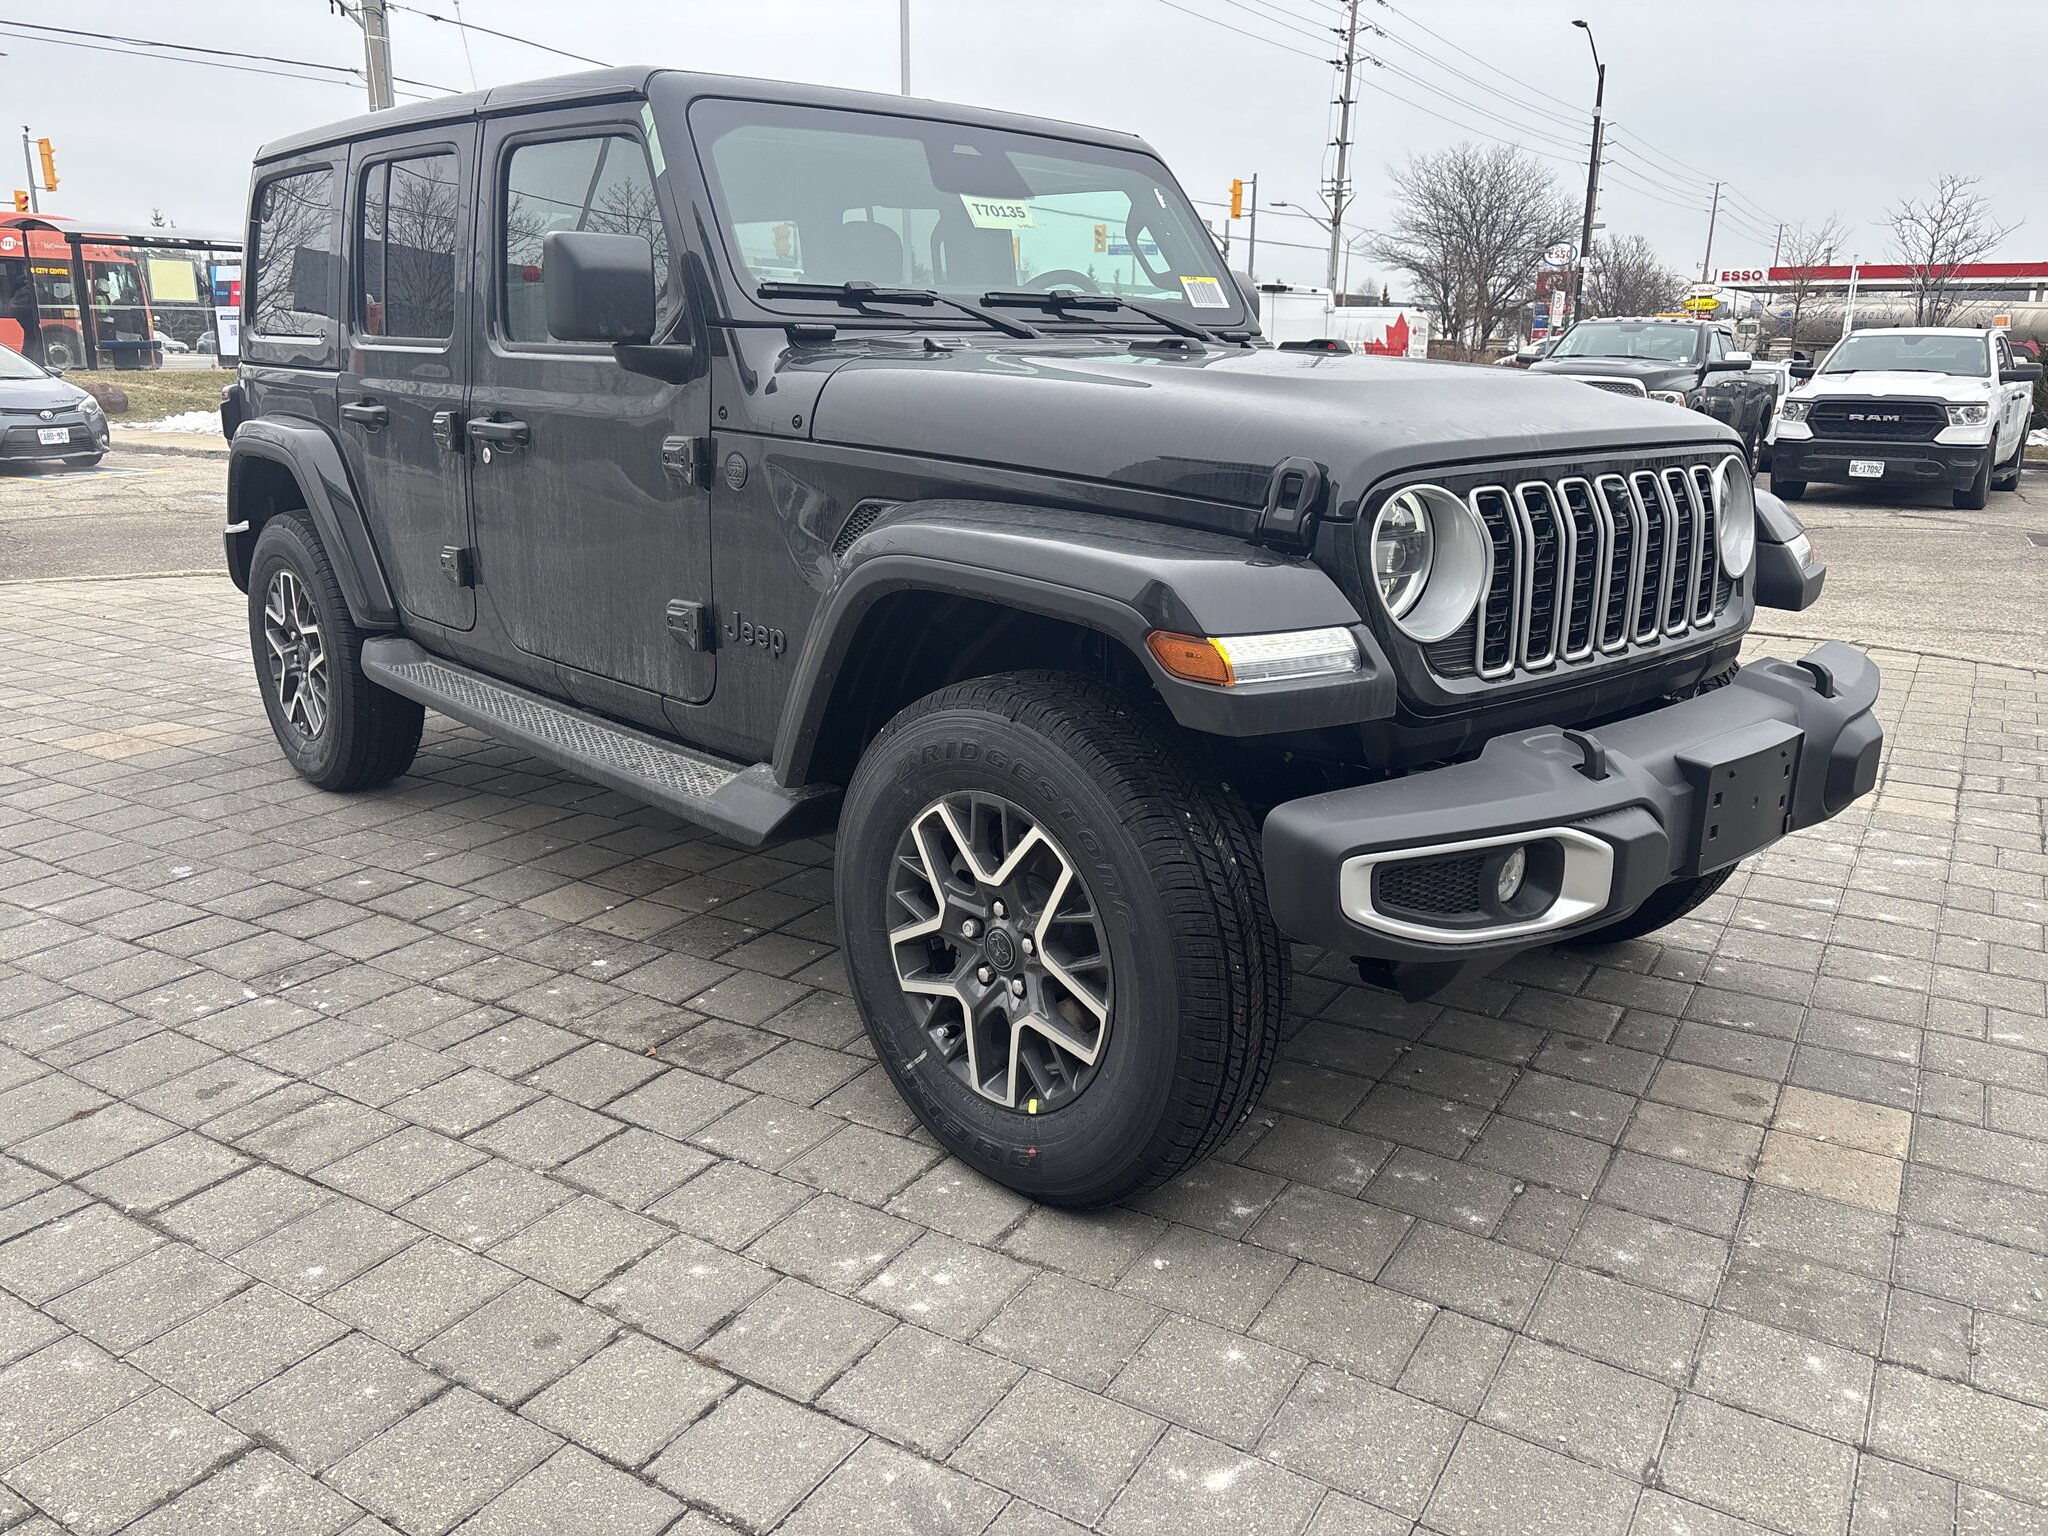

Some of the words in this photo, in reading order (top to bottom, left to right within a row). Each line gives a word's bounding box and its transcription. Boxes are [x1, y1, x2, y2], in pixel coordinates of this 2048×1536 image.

[971, 203, 1026, 219] T70135
[49, 267, 69, 275] CENTRE
[1721, 270, 1763, 282] ESSO
[1841, 311, 1906, 320] PTROLEUM
[1849, 414, 1900, 422] RAM
[723, 610, 788, 660] Jeep
[896, 737, 1139, 937] BRIDGESTONE
